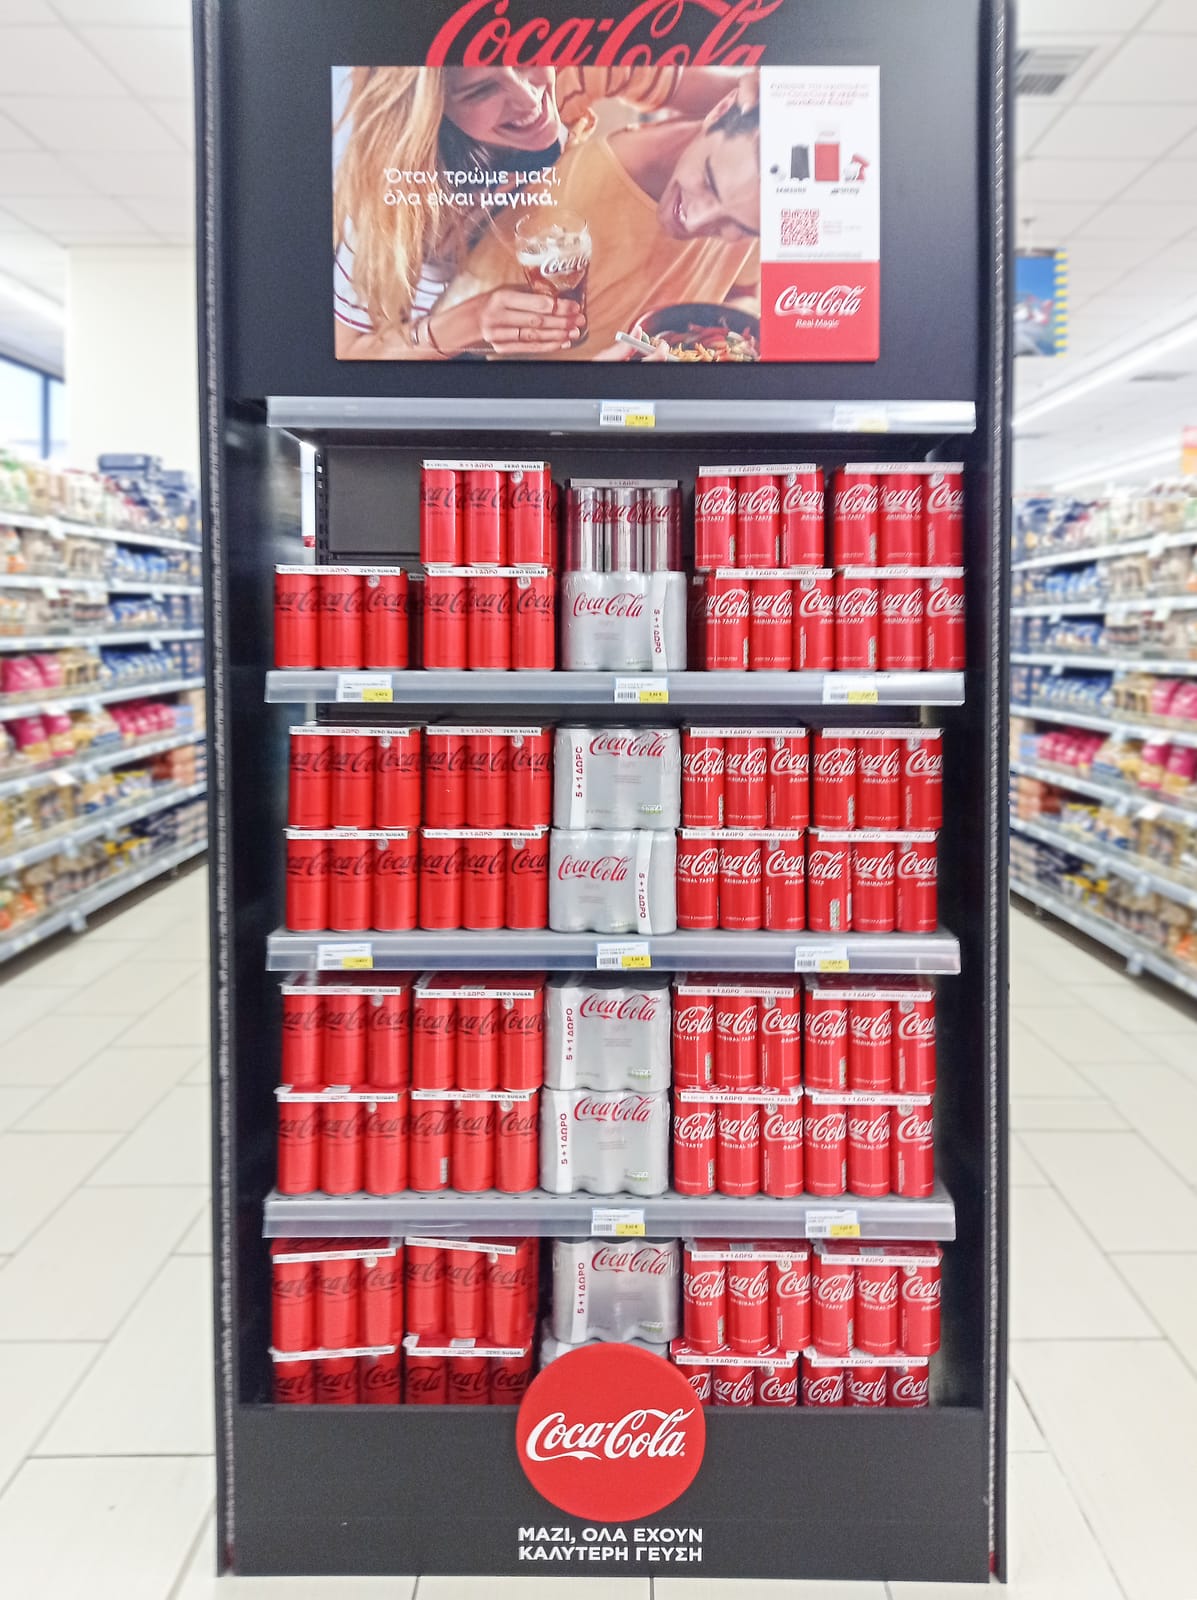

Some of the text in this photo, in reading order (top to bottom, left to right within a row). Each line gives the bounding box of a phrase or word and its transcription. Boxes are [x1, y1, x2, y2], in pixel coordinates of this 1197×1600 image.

[443, 167, 509, 187] τρώμε
[516, 166, 561, 186] μαζί,
[383, 189, 558, 209] όλα είναι μαγικά.
[774, 285, 866, 316] Coca-Cola
[795, 318, 814, 328] Real
[573, 592, 647, 617] Coca-Cola
[589, 731, 671, 757] Coca-Cola
[558, 855, 632, 881] Coca-Cola
[580, 992, 660, 1021] Coca-Cola
[574, 1095, 655, 1122] Coca-Cola
[592, 1247, 671, 1275] Coca-Cola
[526, 1408, 695, 1461] Coca-Cola
[518, 1527, 702, 1543] ΜΑΖΙ, ΟΛΑ ΕΧΟΥΝ
[518, 1547, 702, 1562] ΚΑΛΥΤΕΡΗ ΓΕΥΣΗ
